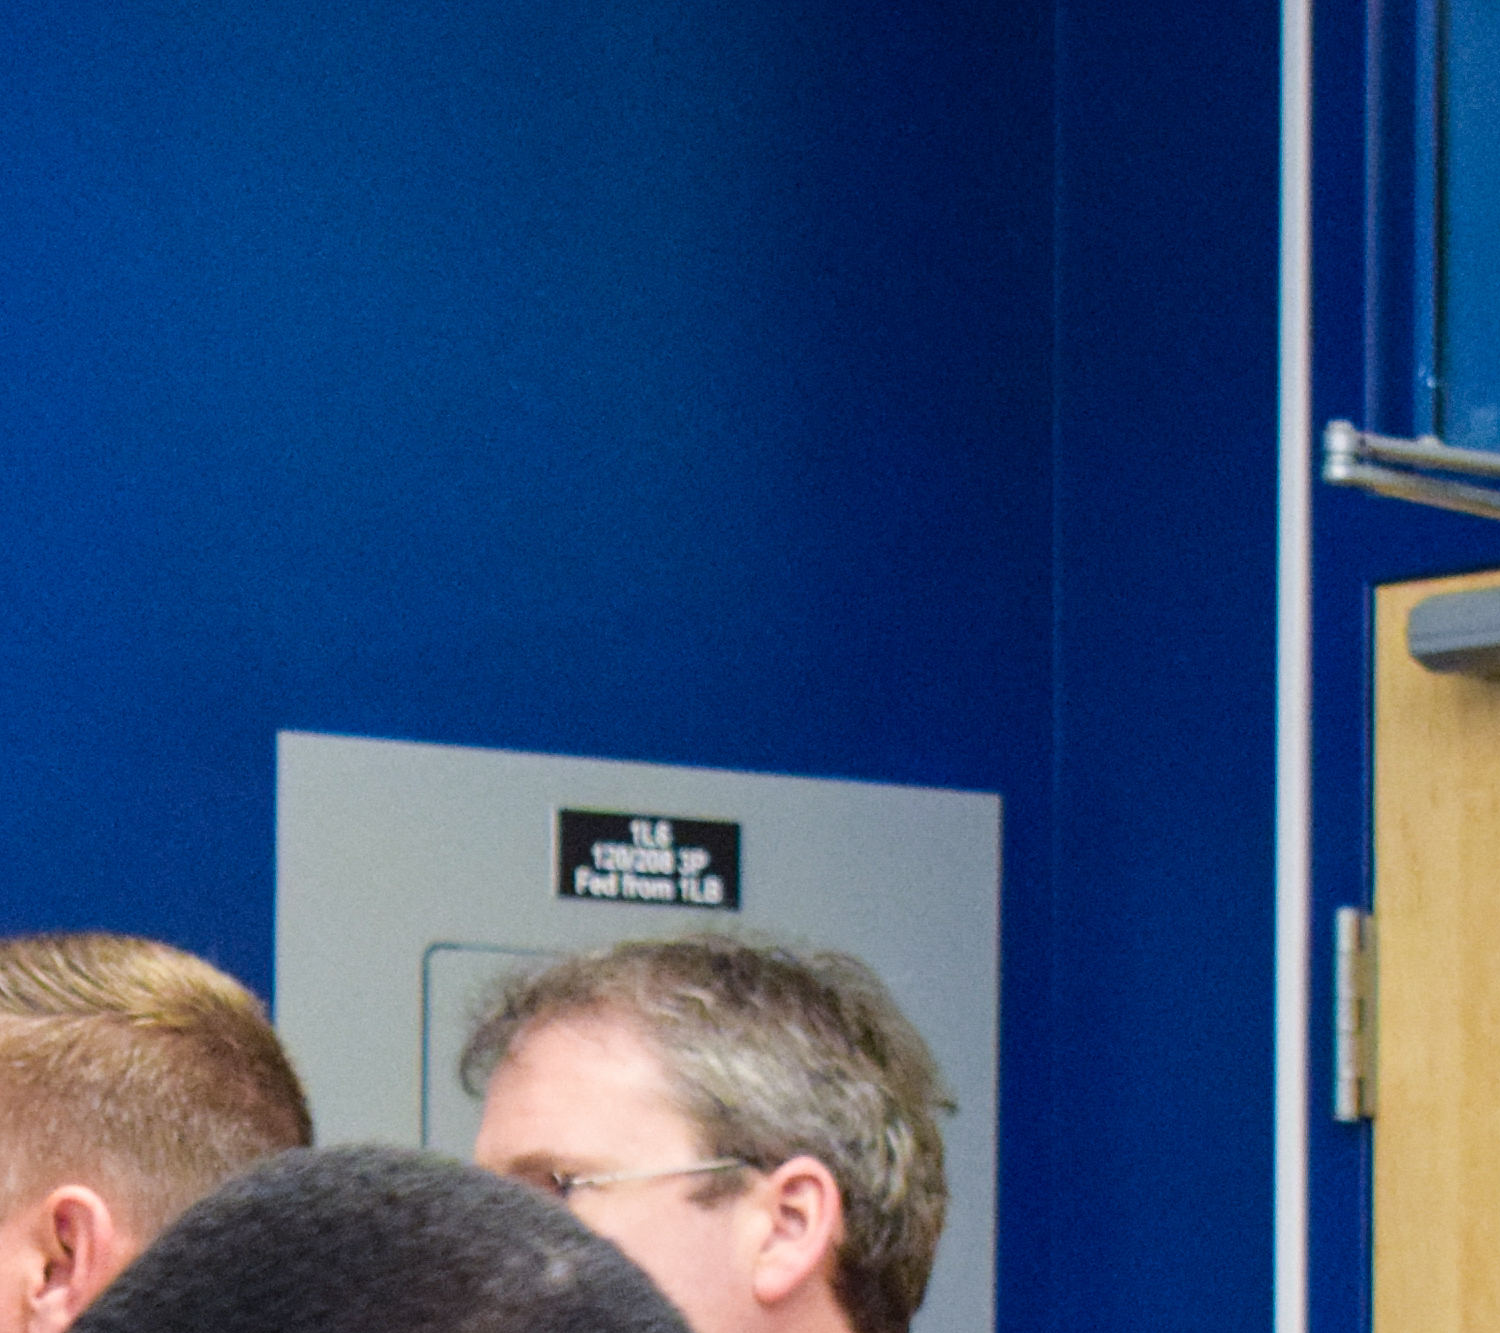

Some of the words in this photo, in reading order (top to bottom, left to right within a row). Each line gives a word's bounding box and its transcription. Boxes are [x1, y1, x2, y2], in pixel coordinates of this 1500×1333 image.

[592, 840, 675, 875] 120/208
[574, 865, 620, 896] Fed
[621, 872, 677, 901] from
